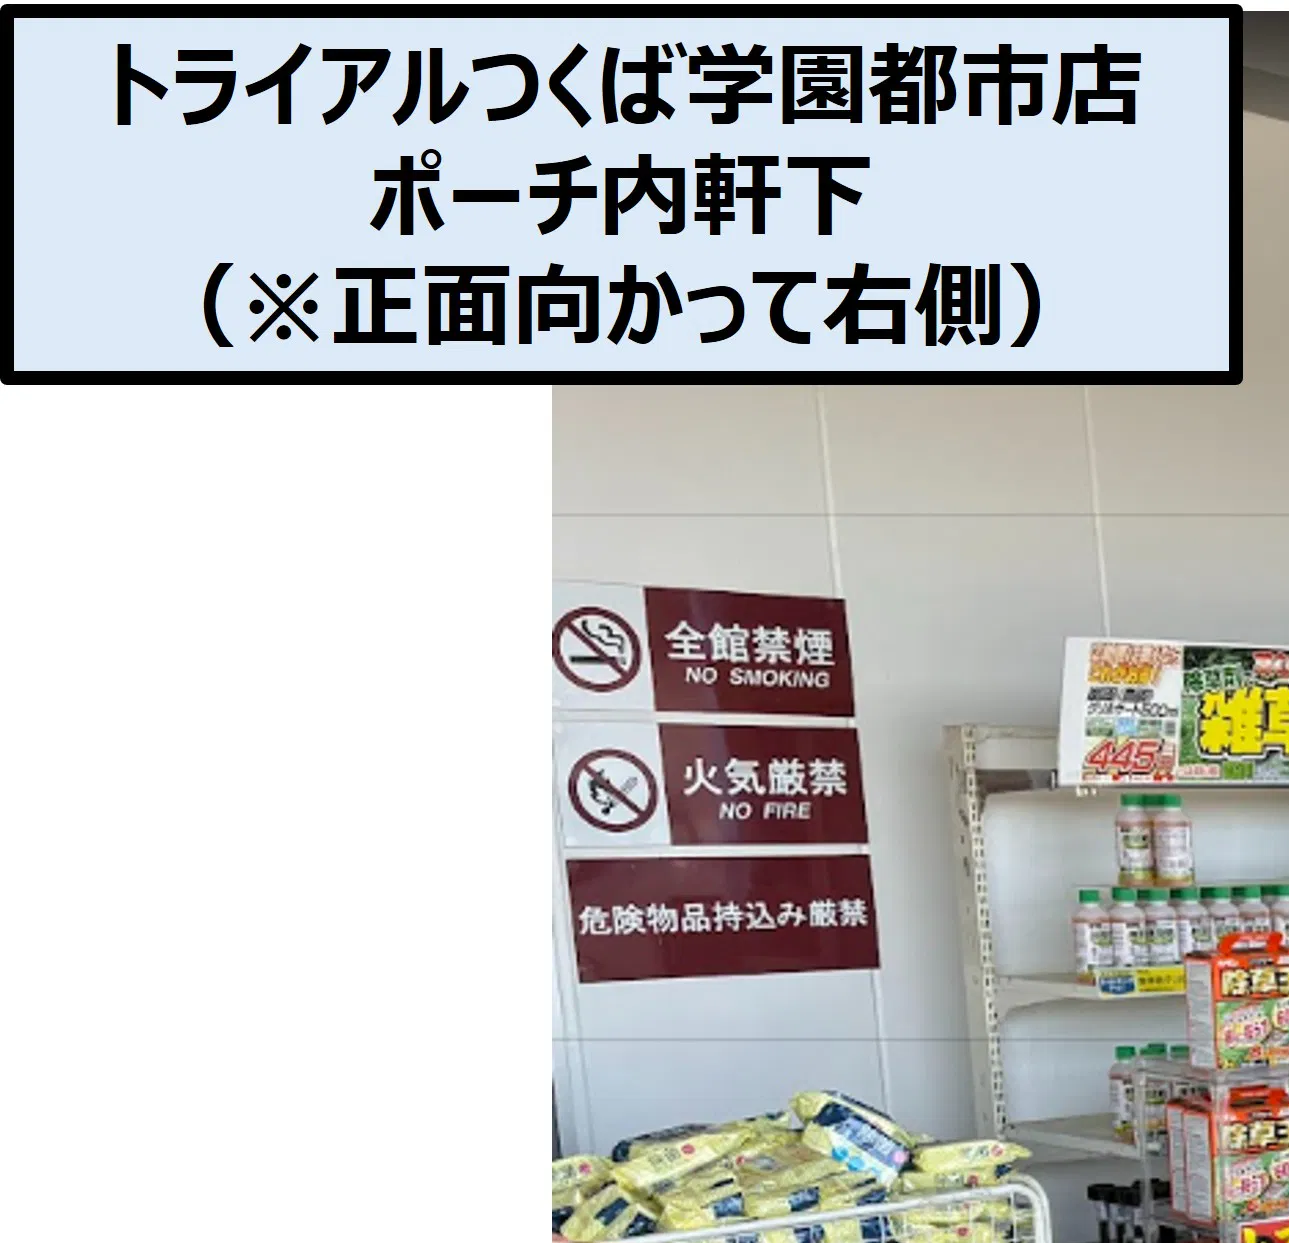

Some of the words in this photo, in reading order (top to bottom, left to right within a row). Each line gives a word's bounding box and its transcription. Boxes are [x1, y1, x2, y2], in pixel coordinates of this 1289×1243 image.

[664, 620, 835, 667] 全館禁煙
[685, 666, 718, 685] NO
[730, 667, 830, 688] SMOKING
[1086, 740, 1160, 770] 445
[683, 757, 847, 796] 火気厳禁
[719, 802, 752, 820] NO
[763, 802, 811, 819] FIRE
[578, 898, 867, 936] 危険物品持込み厳禁
